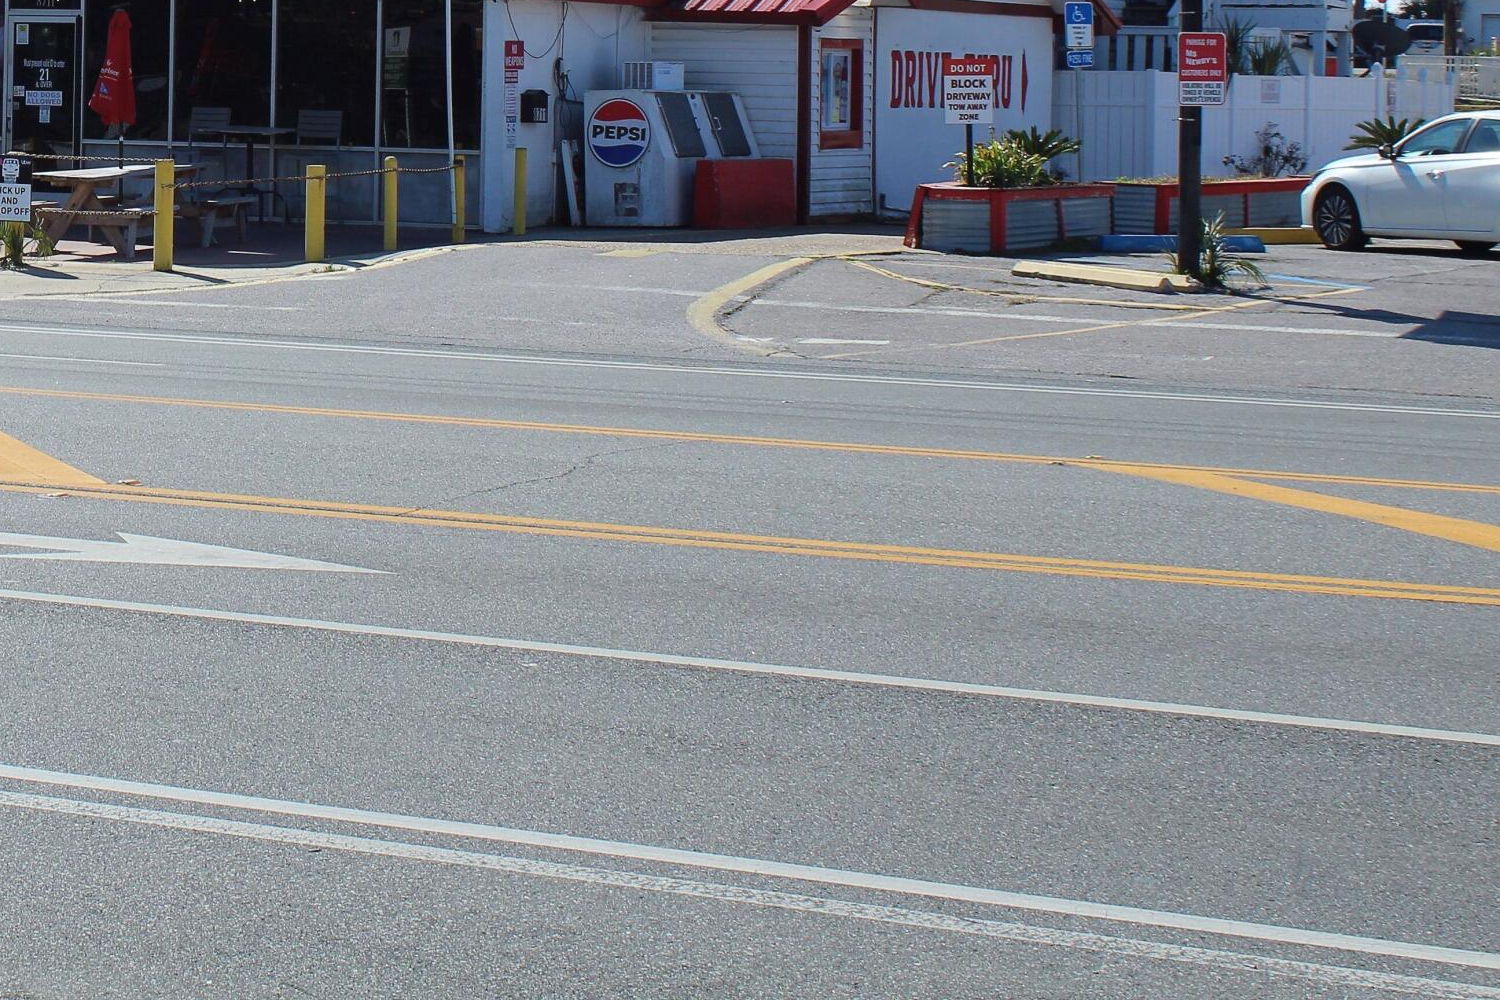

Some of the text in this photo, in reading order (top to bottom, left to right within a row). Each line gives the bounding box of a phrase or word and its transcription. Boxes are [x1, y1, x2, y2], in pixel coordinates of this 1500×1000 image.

[951, 64, 987, 73] DO NOT
[39, 68, 49, 80] 21
[951, 79, 987, 88] BLOCK
[946, 92, 991, 101] DRIVEWAY
[592, 124, 647, 142] PEPSI
[14, 187, 26, 195] UP
[14, 207, 29, 215] OFF
